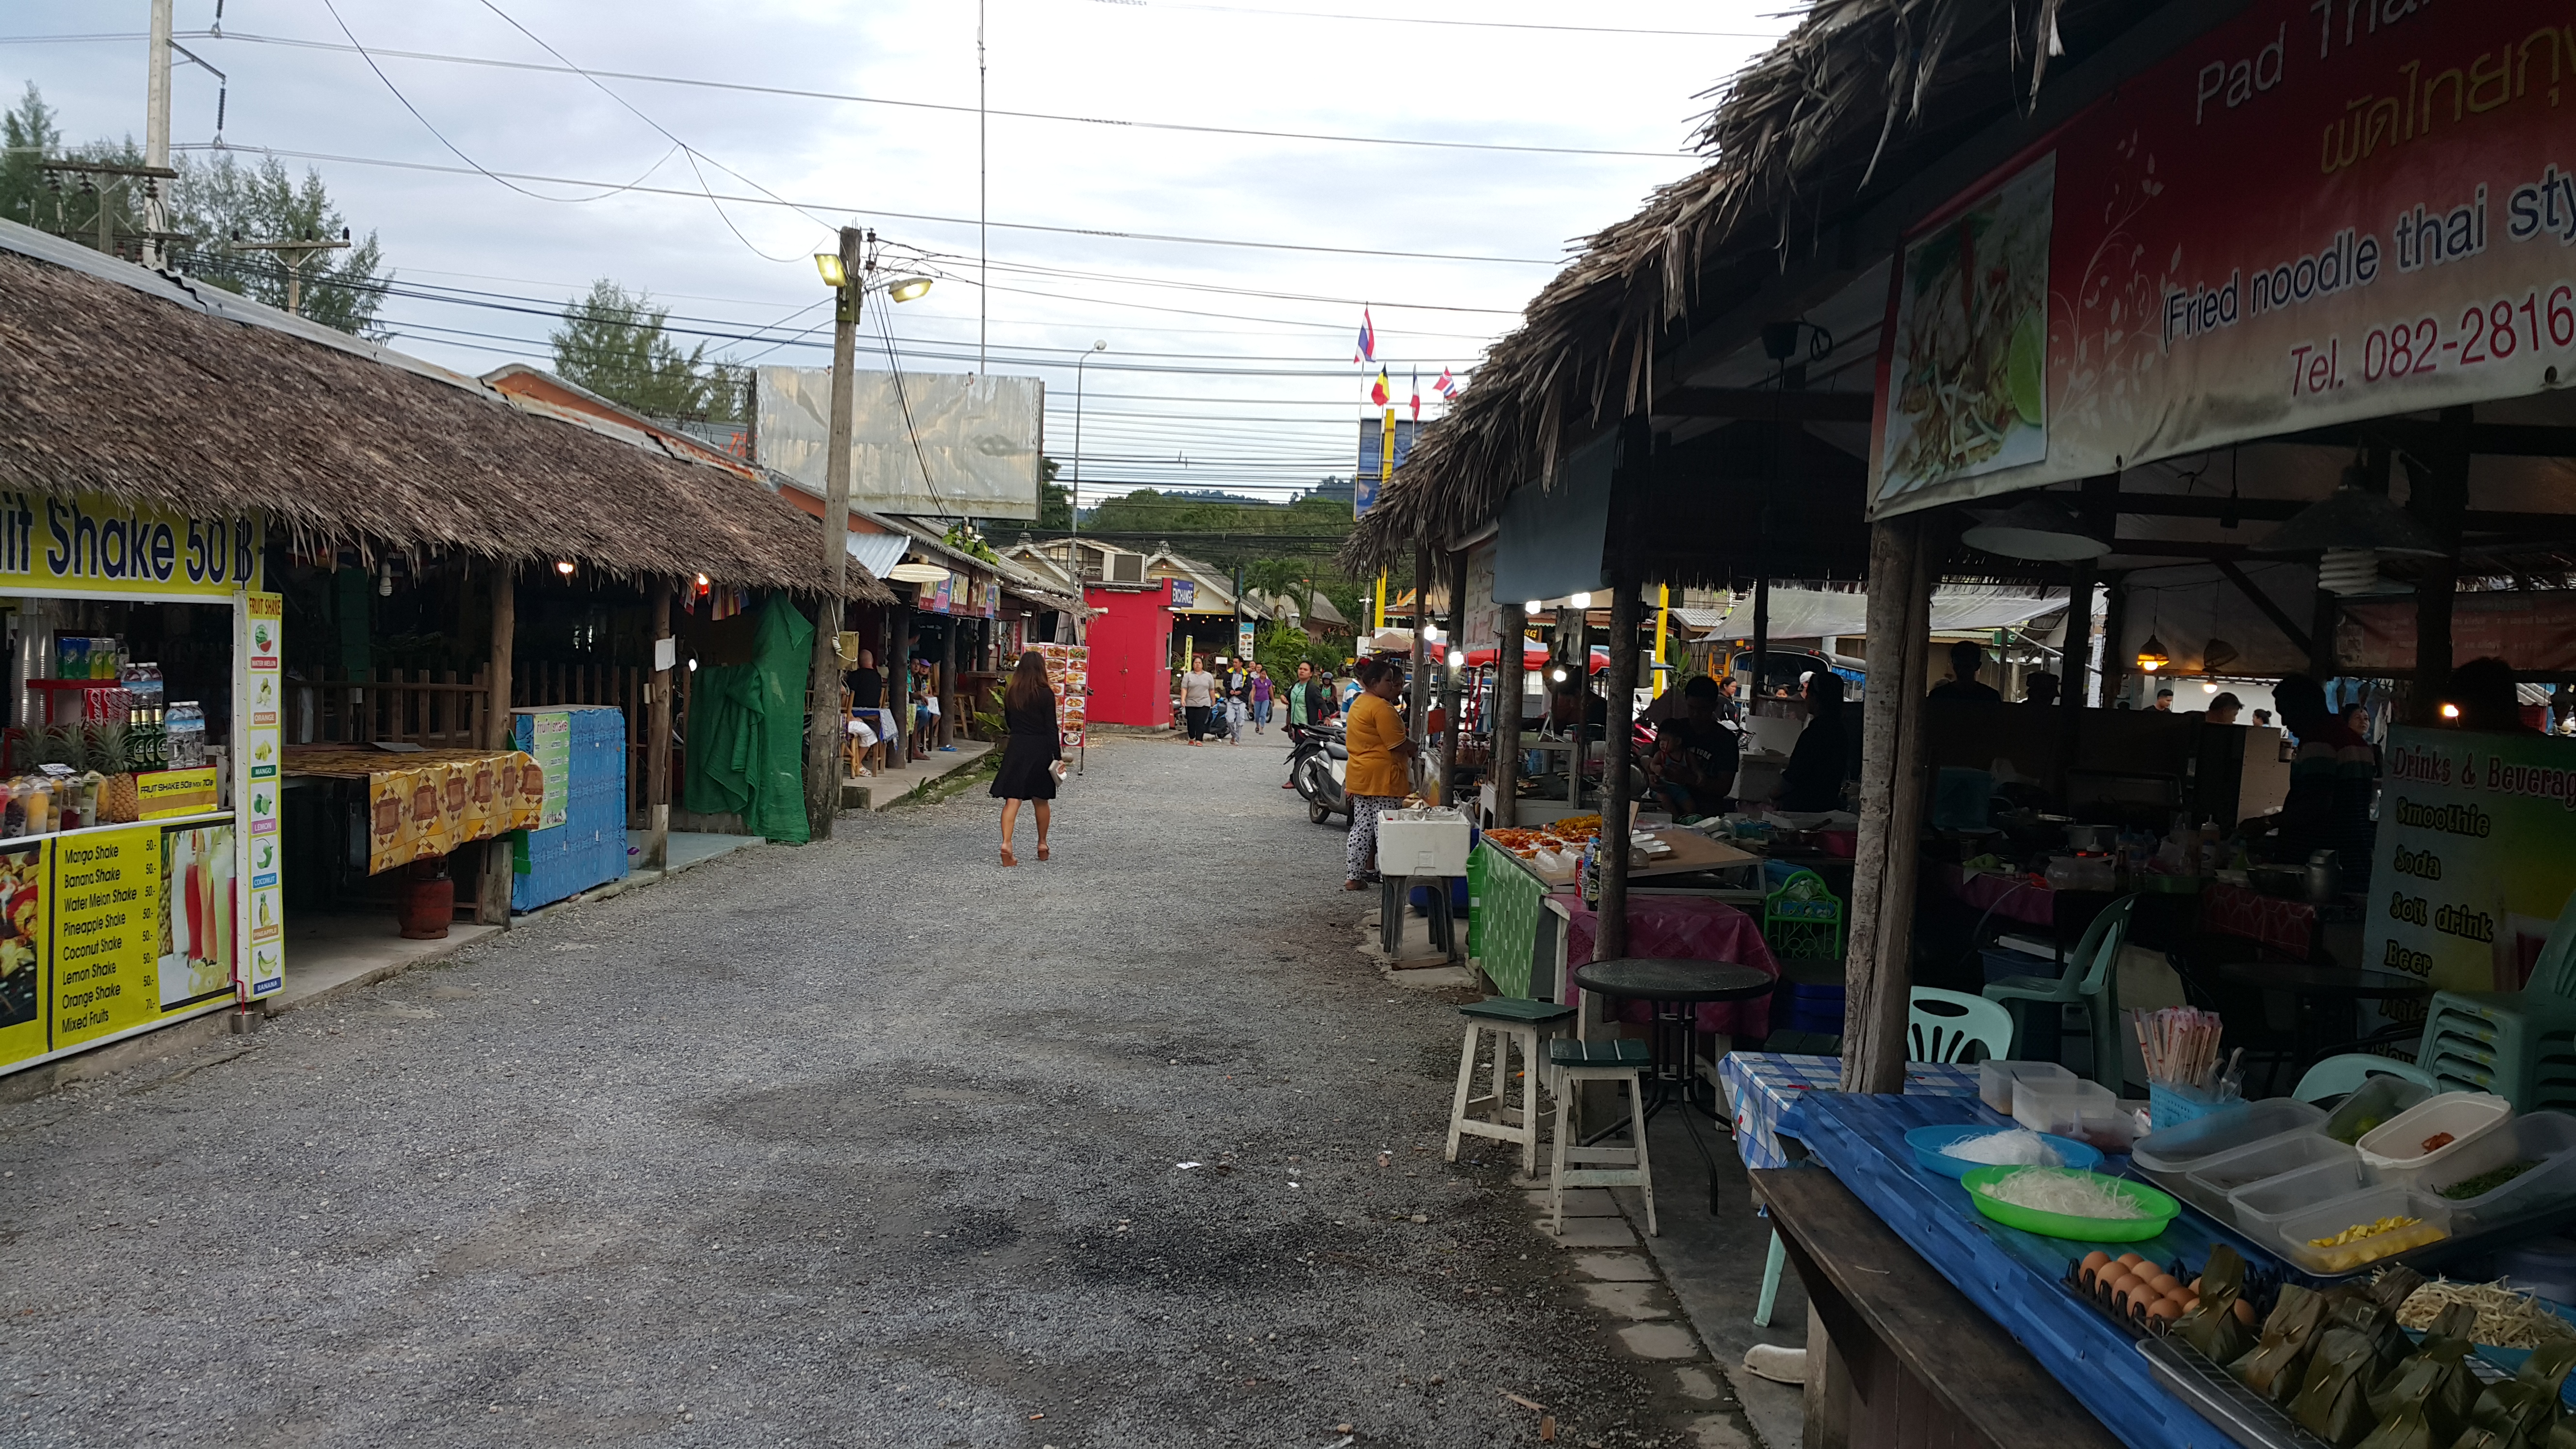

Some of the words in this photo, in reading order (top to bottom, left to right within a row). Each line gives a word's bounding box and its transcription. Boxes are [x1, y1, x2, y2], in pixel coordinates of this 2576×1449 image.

[2196, 21, 2286, 125] Pad
[2253, 232, 2378, 313] noodle
[2397, 188, 2485, 267] thai
[2291, 339, 2344, 397] Tel.
[2365, 285, 2574, 384] 082-2816
[47, 496, 174, 581] Shake
[186, 515, 226, 583] 50
[249, 597, 263, 615] FRUIT
[265, 598, 281, 615] SHAKE
[1173, 588, 1193, 604] EXCHANGE
[2393, 745, 2451, 785] Drinks
[158, 782, 179, 791] SHAKE
[254, 822, 272, 831] LEMON
[2397, 796, 2490, 838] Smoothie
[65, 849, 93, 865] Mango
[95, 844, 119, 860] Shake
[2394, 844, 2441, 881] Soda
[64, 873, 94, 888] Banana
[95, 867, 121, 883] Shake
[254, 876, 275, 886] COCONUT
[64, 896, 87, 912] Water
[89, 892, 111, 908] Melon
[113, 887, 137, 903] Shake
[64, 916, 103, 937] Pineapple
[105, 912, 126, 928] Shake
[2390, 891, 2427, 926] Soft
[2435, 904, 2494, 943] drink
[254, 928, 277, 938] PINEAPPLE
[63, 940, 99, 961] Coconut
[101, 936, 122, 952] Shake
[2384, 939, 2432, 978] Beer
[63, 968, 90, 985] Lemon
[92, 961, 116, 978] Shake
[63, 991, 94, 1009] Orange
[96, 983, 121, 1000] Shake
[257, 981, 277, 992] BANANA
[62, 1013, 87, 1033] Mixed
[89, 1008, 109, 1026] Fruits
